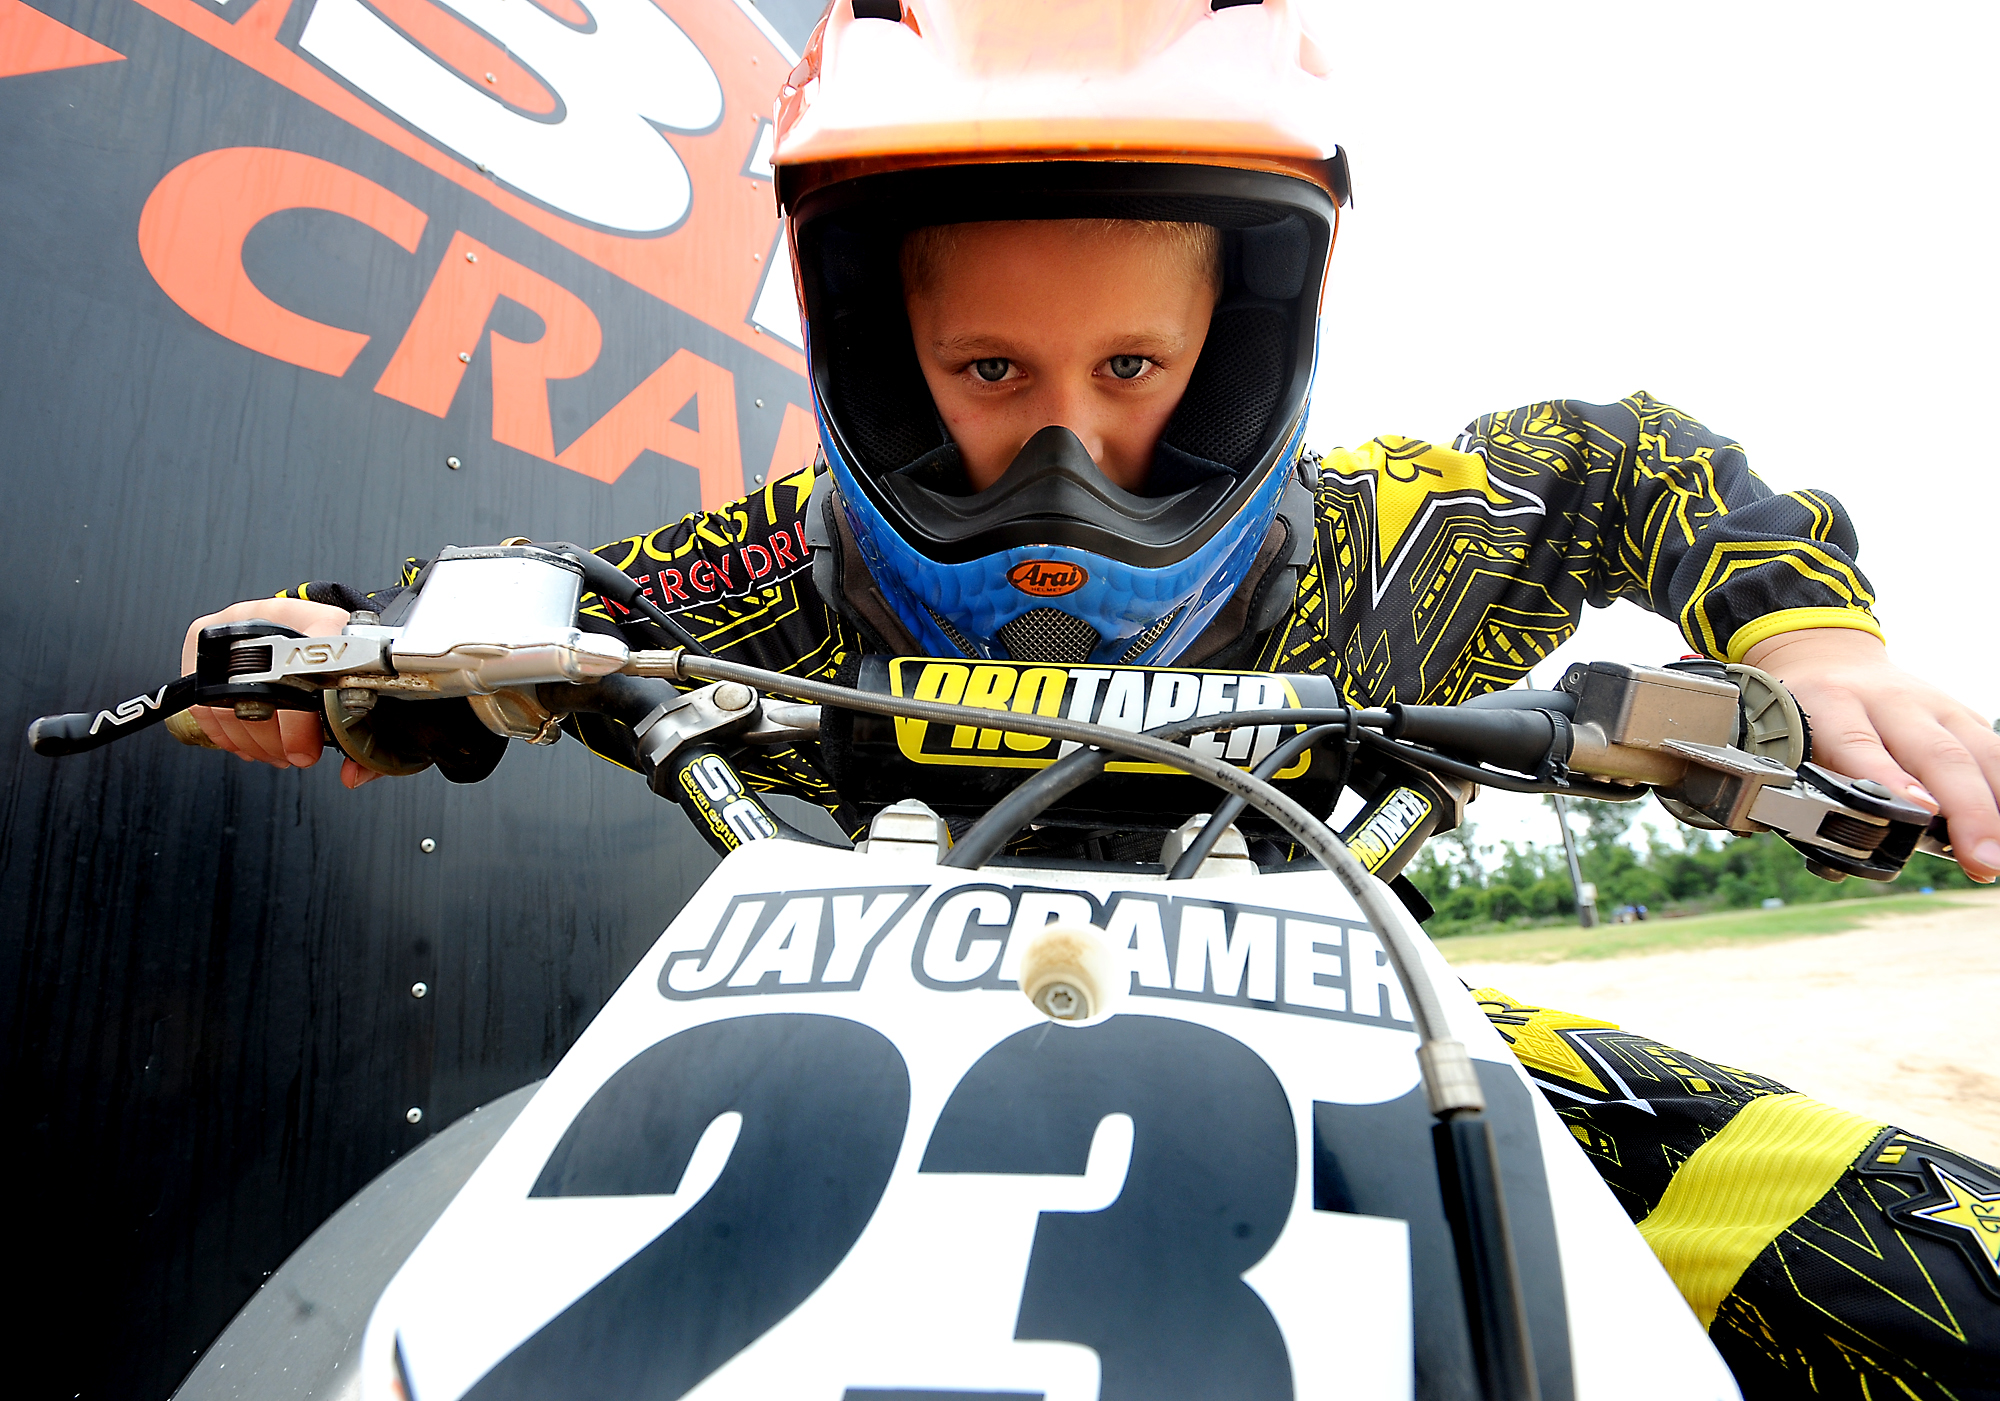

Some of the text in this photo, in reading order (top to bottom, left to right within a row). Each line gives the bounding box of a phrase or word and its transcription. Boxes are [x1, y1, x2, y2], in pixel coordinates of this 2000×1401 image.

[138, 147, 818, 512] CRA
[1013, 565, 1078, 587] Arai
[285, 642, 349, 667] ASV
[89, 684, 168, 735] ASV
[897, 663, 1288, 767] PROTAPER
[682, 770, 711, 811] seven
[659, 886, 924, 998] JAY
[455, 1010, 1576, 1401] 231
